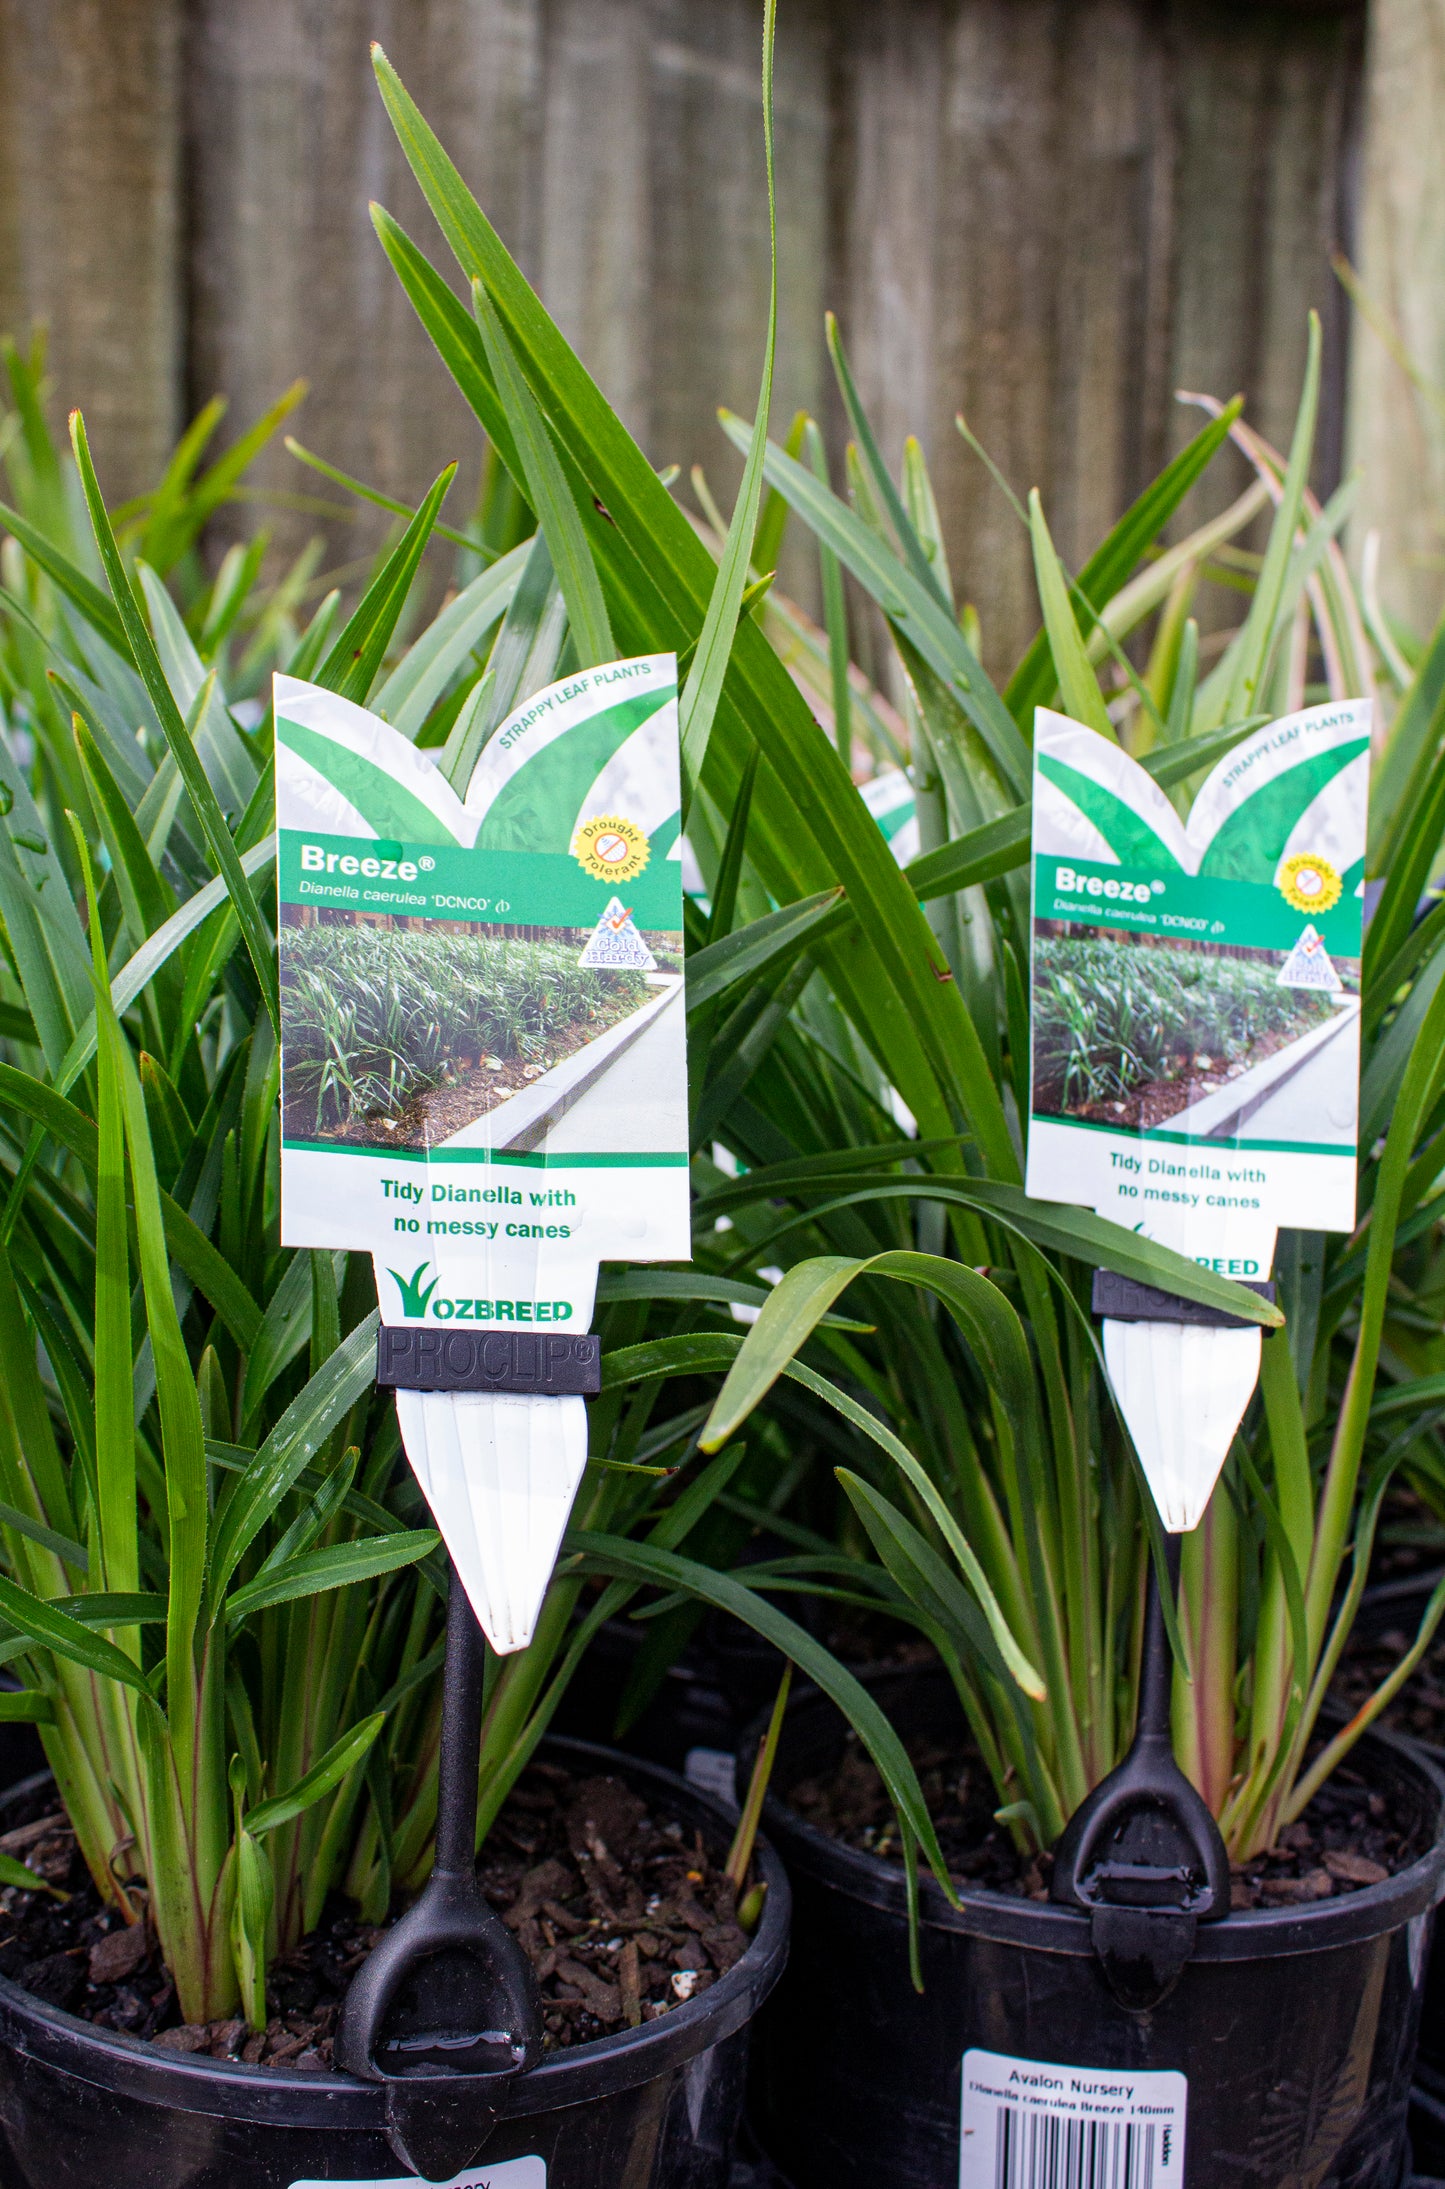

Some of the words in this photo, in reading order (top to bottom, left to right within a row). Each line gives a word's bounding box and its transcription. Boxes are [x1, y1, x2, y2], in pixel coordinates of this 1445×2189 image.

[499, 697, 554, 749] STRAPPY
[555, 679, 591, 704] LEAF
[594, 663, 651, 686] PLANTS
[1222, 741, 1270, 788] STRAPPY
[1271, 726, 1300, 749] LEAF
[1304, 712, 1355, 733] PLANTS
[583, 821, 640, 843] Drought
[584, 852, 641, 876] Tolerant
[299, 880, 360, 899] Dianella
[363, 889, 427, 906] caerulea
[1053, 898, 1103, 916] Dianella
[595, 938, 640, 953] Cold
[587, 950, 650, 968] Hardy
[1109, 1152, 1143, 1174] Tidy
[1148, 1159, 1221, 1180] Dianella
[1227, 1168, 1266, 1183] with
[381, 1179, 424, 1205] Tidy
[431, 1183, 523, 1205] Dianella
[529, 1189, 576, 1207] with
[1118, 1183, 1138, 1198] no
[1143, 1188, 1200, 1208] messy
[1206, 1194, 1260, 1209] canes
[394, 1217, 420, 1233] no
[427, 1220, 499, 1240] messy
[505, 1222, 571, 1240] canes
[432, 1298, 574, 1322] OZBREED
[1009, 2069, 1064, 2091] Avalon
[1070, 2079, 1135, 2100] Nursery
[1023, 2094, 1077, 2110] caerulea
[1080, 2101, 1125, 2114] Breeze
[1130, 2104, 1175, 2115] 140mm
